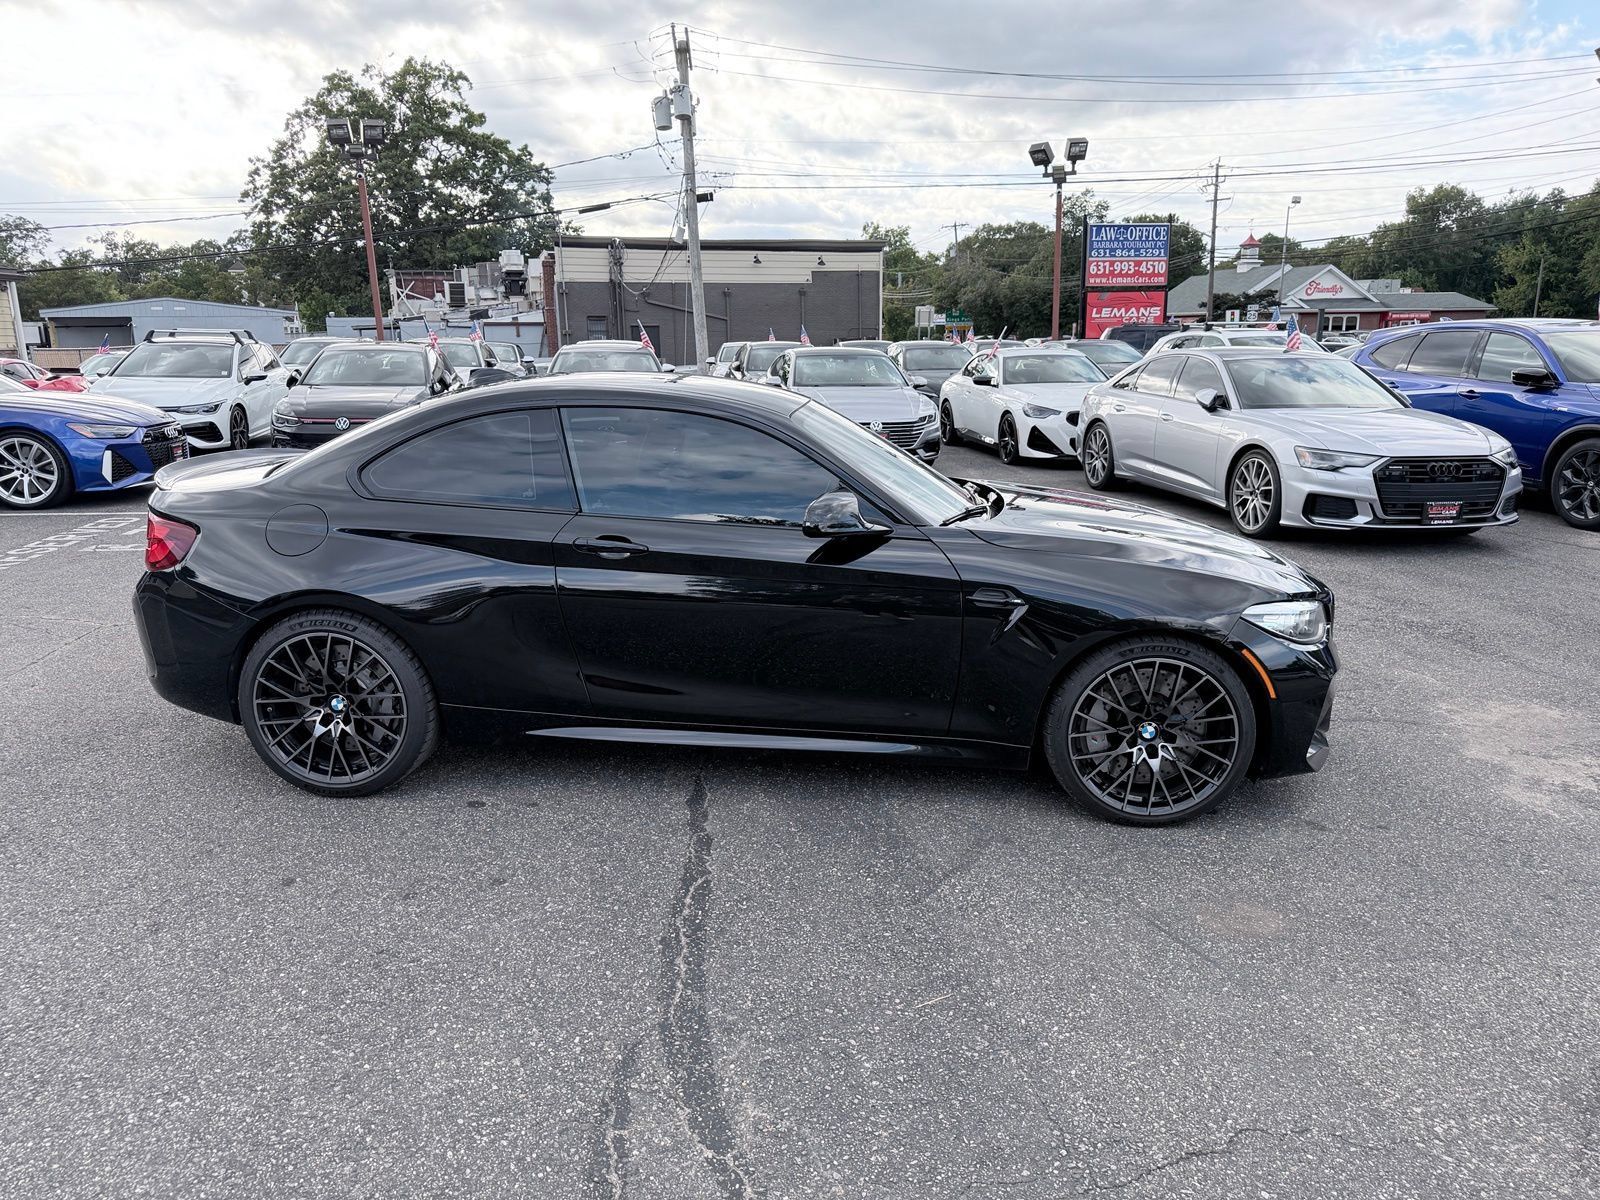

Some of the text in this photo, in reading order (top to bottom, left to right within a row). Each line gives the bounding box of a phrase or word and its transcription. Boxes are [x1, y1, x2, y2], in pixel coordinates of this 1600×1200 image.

[1091, 226, 1168, 241] LAW OFFICE
[1093, 241, 1165, 249] BARBARA TOUHAMY PC
[1091, 249, 1165, 257] 631-864-5291
[1089, 261, 1166, 274] 631-993-4510
[1089, 275, 1165, 284] www.LemansCars.com
[1091, 307, 1161, 318] LEMANS
[1122, 316, 1154, 324] CARS
[302, 620, 353, 633] MICHELIN
